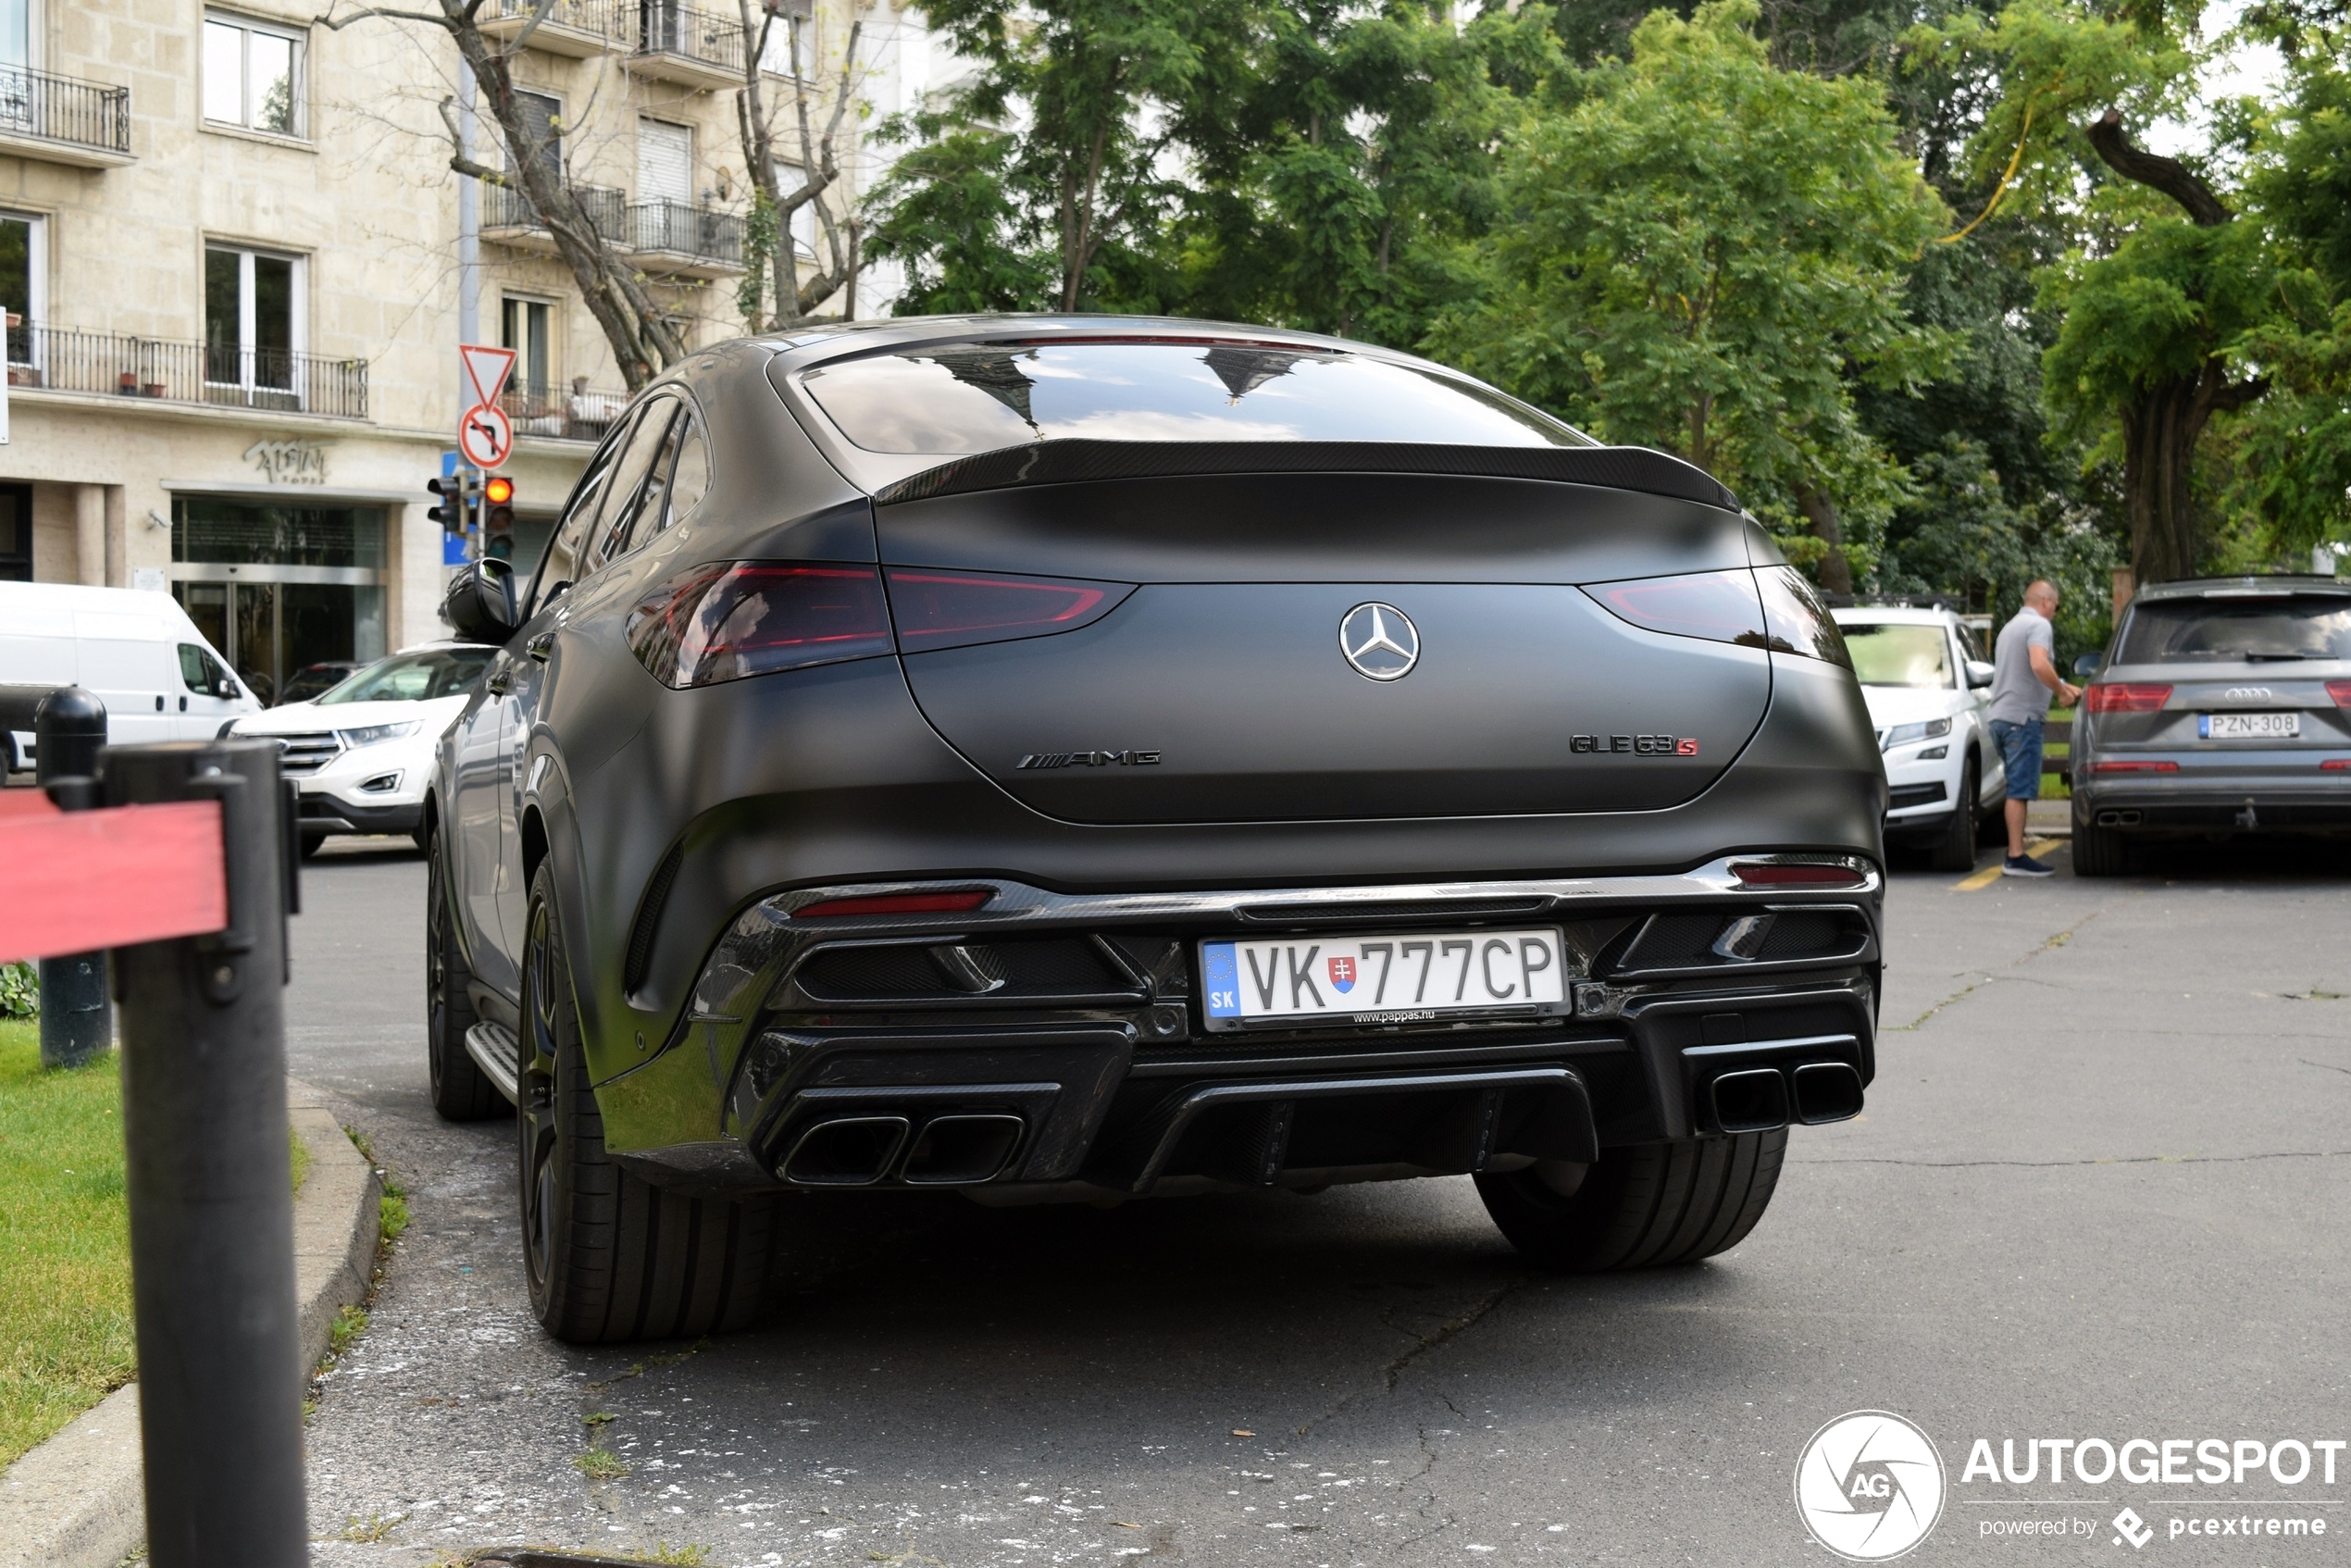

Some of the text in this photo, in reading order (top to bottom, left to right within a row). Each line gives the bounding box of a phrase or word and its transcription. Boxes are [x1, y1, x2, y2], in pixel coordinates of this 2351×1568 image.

[2213, 716, 2294, 732] PZN-308
[1211, 991, 1235, 1009] SK
[1353, 1009, 1435, 1025] www.pappas.hu
